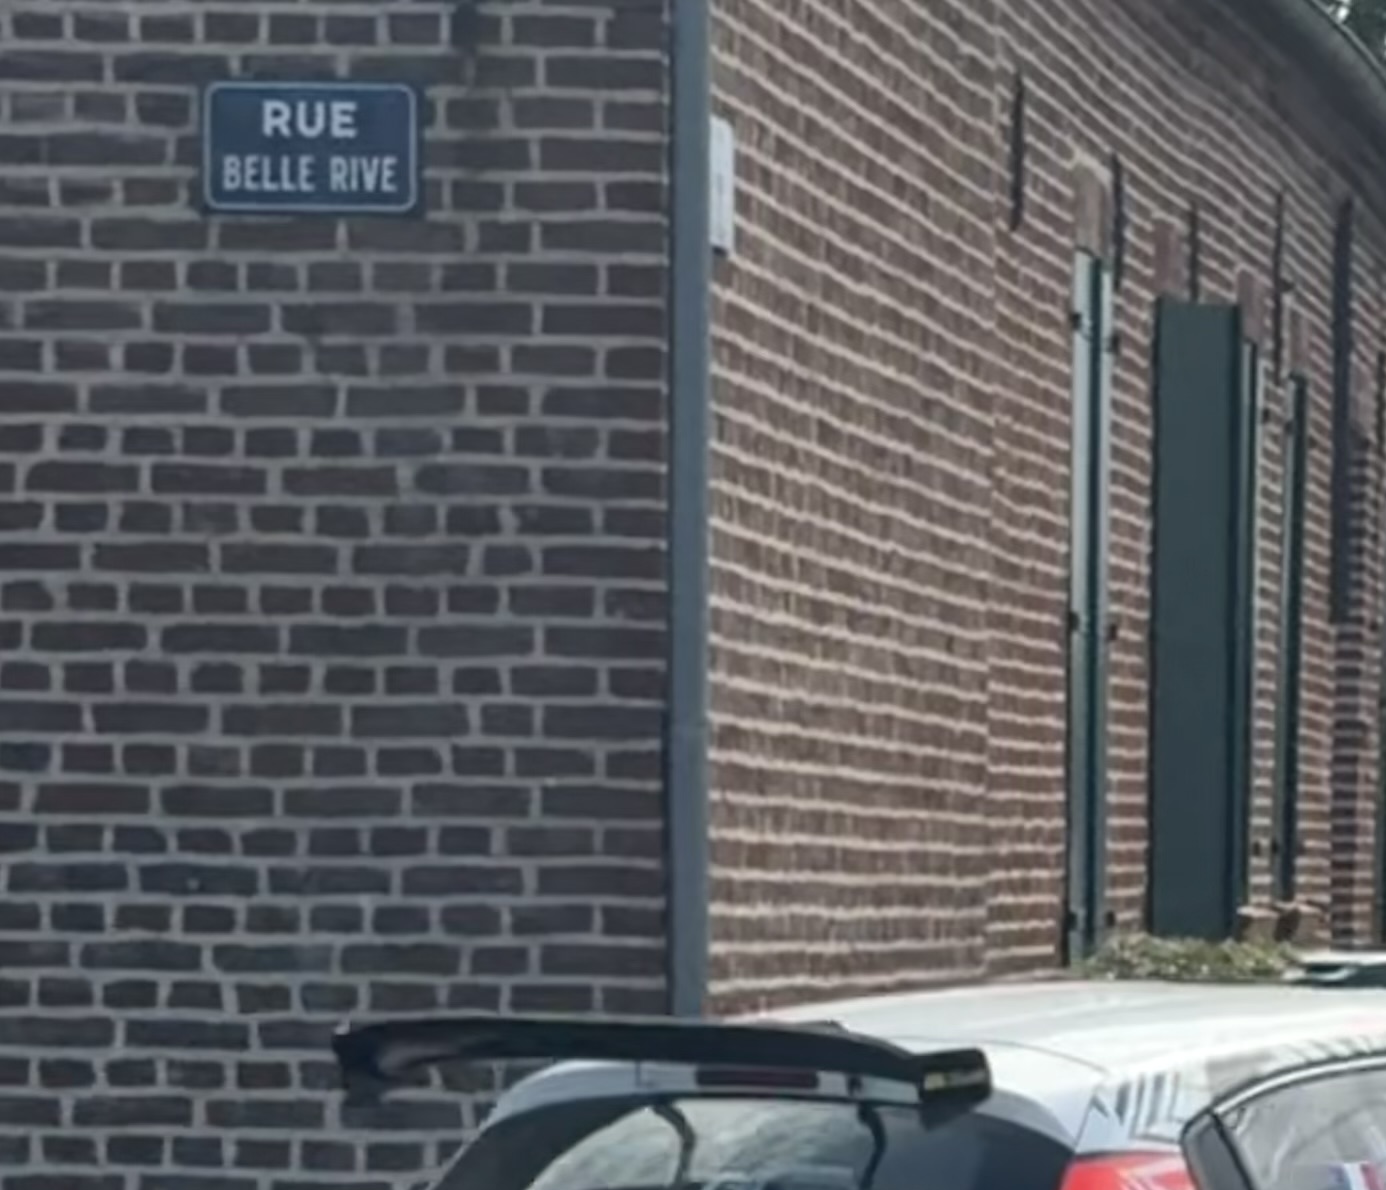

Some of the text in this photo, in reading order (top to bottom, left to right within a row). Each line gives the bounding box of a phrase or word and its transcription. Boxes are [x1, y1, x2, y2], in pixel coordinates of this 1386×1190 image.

[262, 99, 358, 138] RUE
[222, 154, 398, 192] BELLE RIVE
